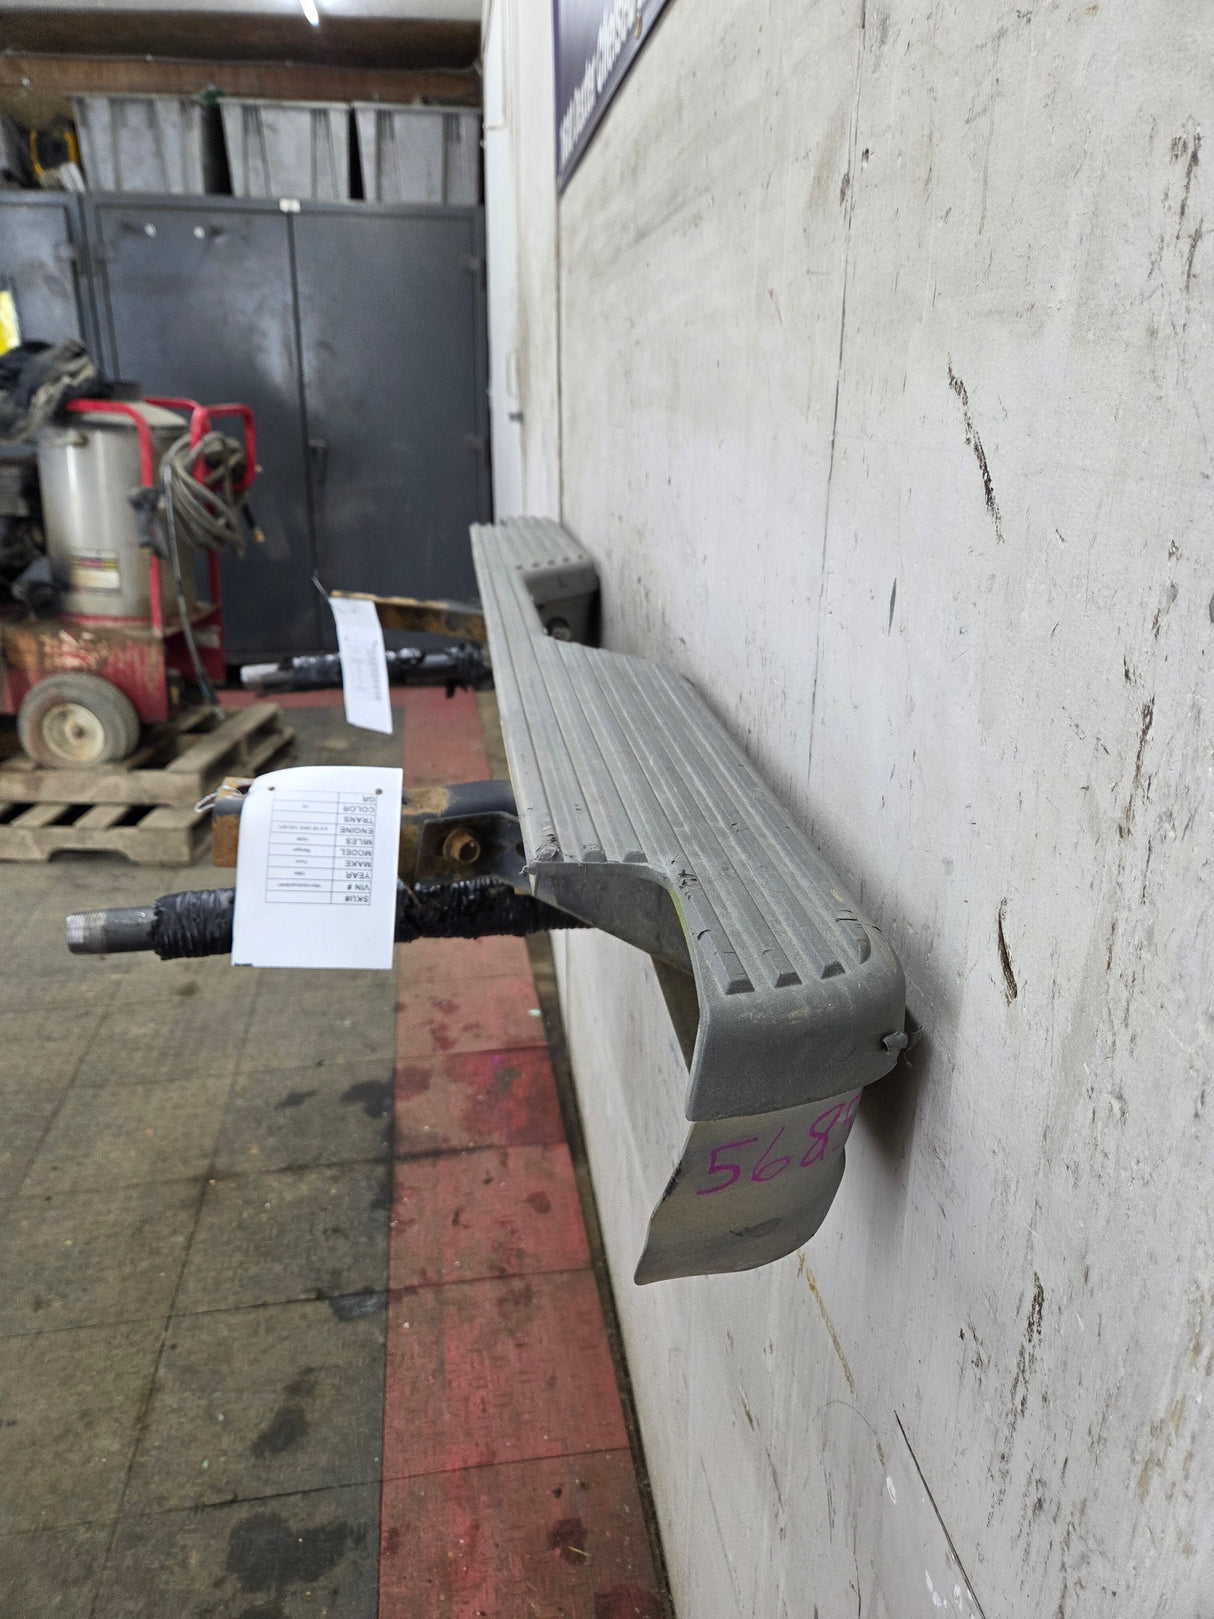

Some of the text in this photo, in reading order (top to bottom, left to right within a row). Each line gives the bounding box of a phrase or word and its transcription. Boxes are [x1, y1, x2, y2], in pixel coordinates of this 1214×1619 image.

[343, 805, 375, 813] COLOR
[343, 815, 374, 823] TRANS
[339, 826, 373, 834] ENGINE
[345, 837, 372, 845] MILES
[340, 848, 372, 856] MODEL
[345, 859, 371, 867] MAKE
[345, 871, 370, 879] YEAR
[345, 895, 369, 903] SKU#
